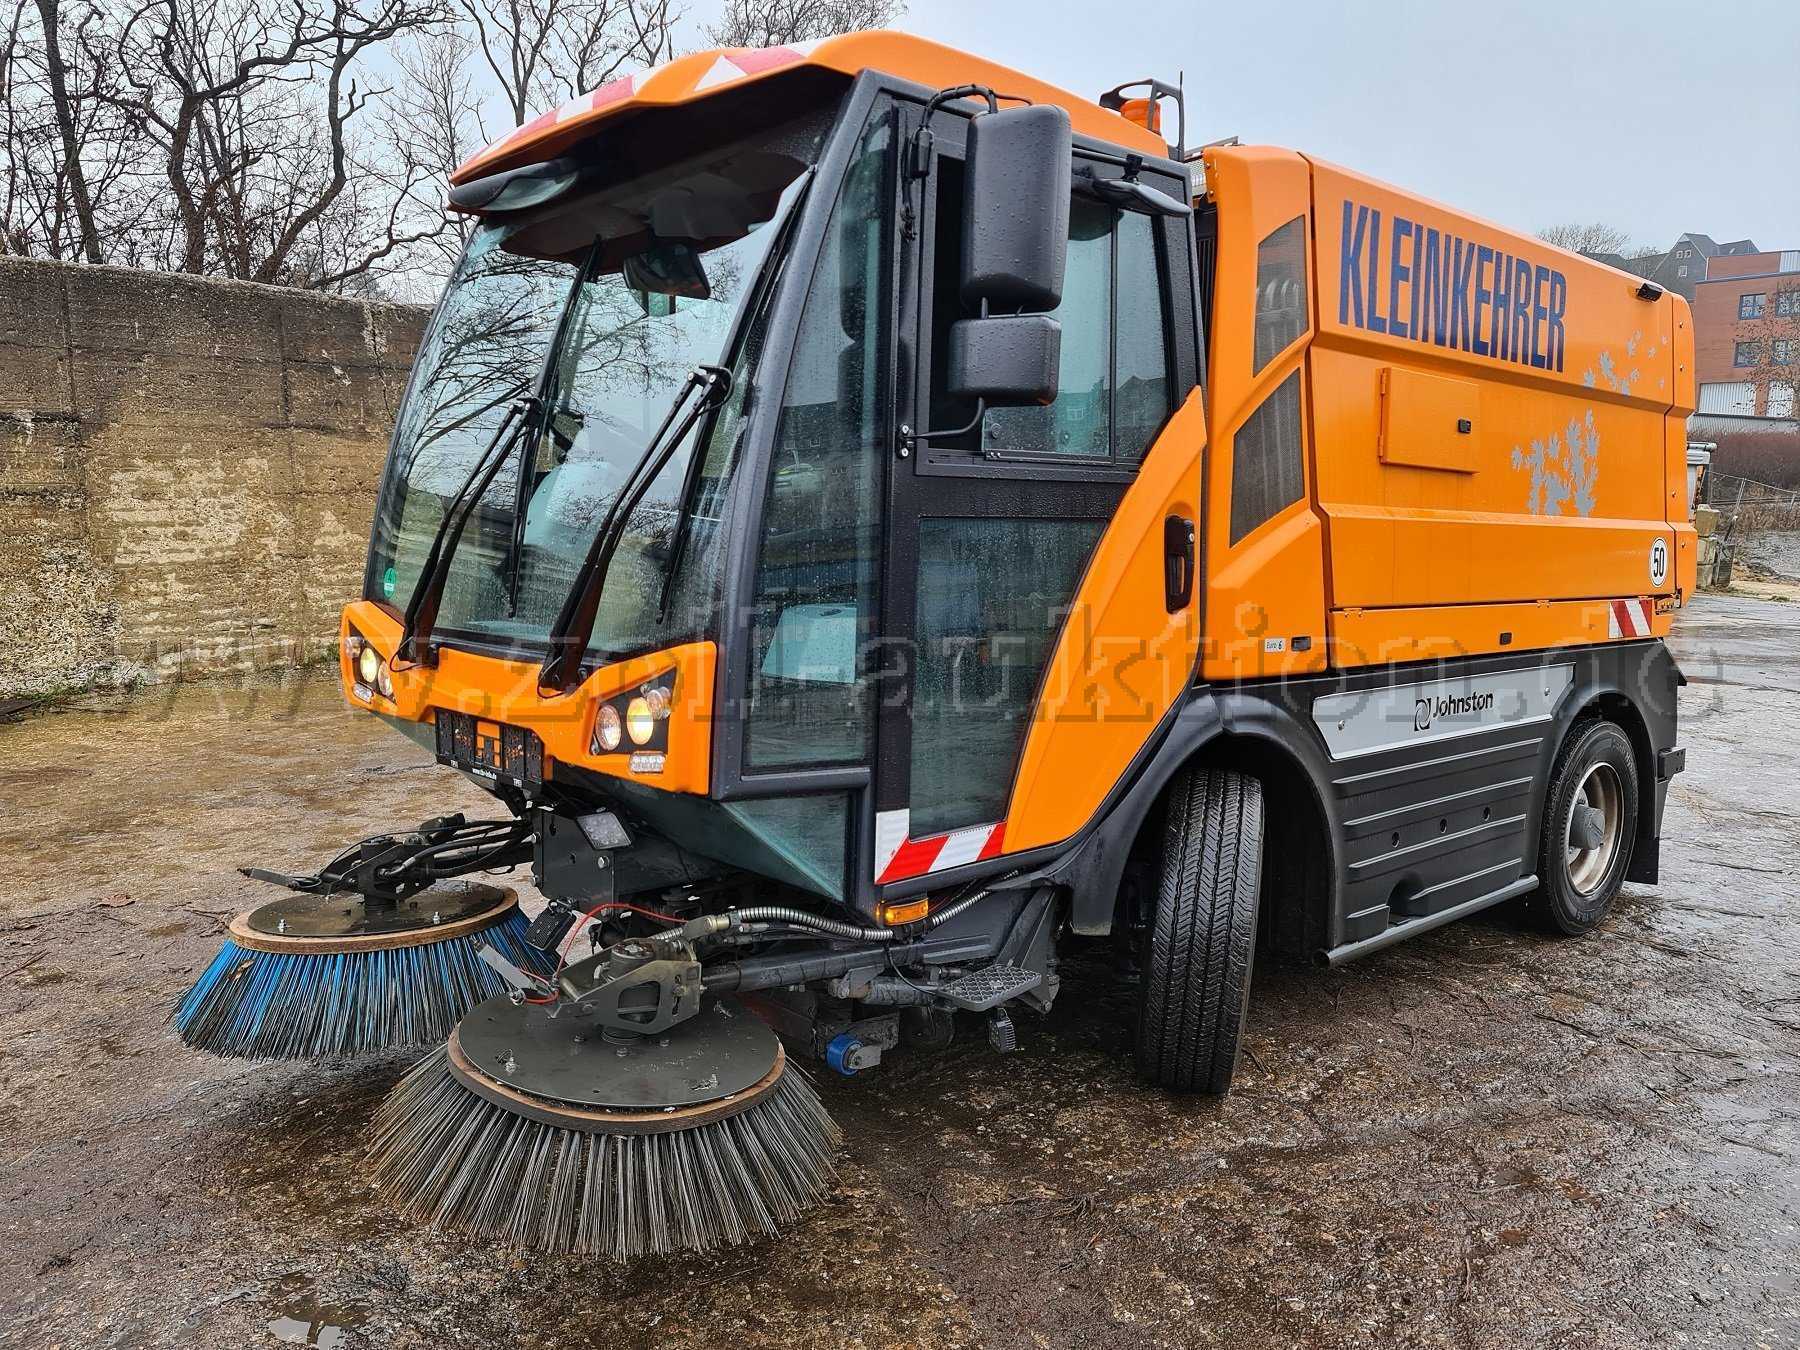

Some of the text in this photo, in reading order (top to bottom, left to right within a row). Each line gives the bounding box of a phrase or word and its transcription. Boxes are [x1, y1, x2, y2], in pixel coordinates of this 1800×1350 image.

[1339, 199, 1567, 373] KLEINKEHRER
[1653, 547, 1665, 577] 50
[1432, 691, 1494, 718] Johnston
